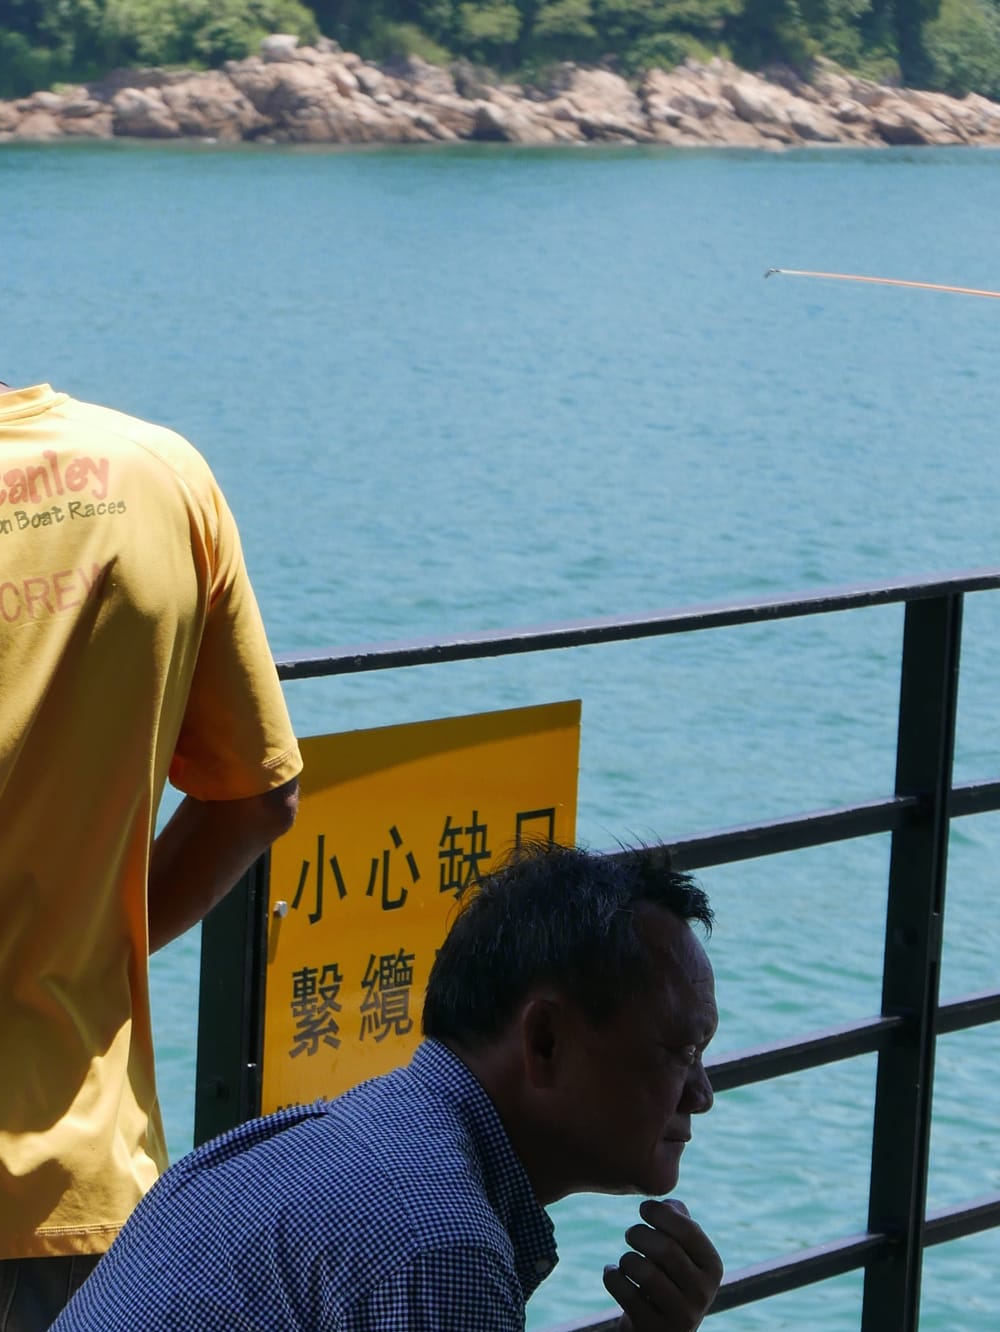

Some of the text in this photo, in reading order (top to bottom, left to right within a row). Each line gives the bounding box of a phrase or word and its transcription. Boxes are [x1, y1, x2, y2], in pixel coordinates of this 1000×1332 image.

[15, 507, 64, 530] Boat
[68, 500, 127, 520] Races
[288, 948, 440, 1059] 繫纜
